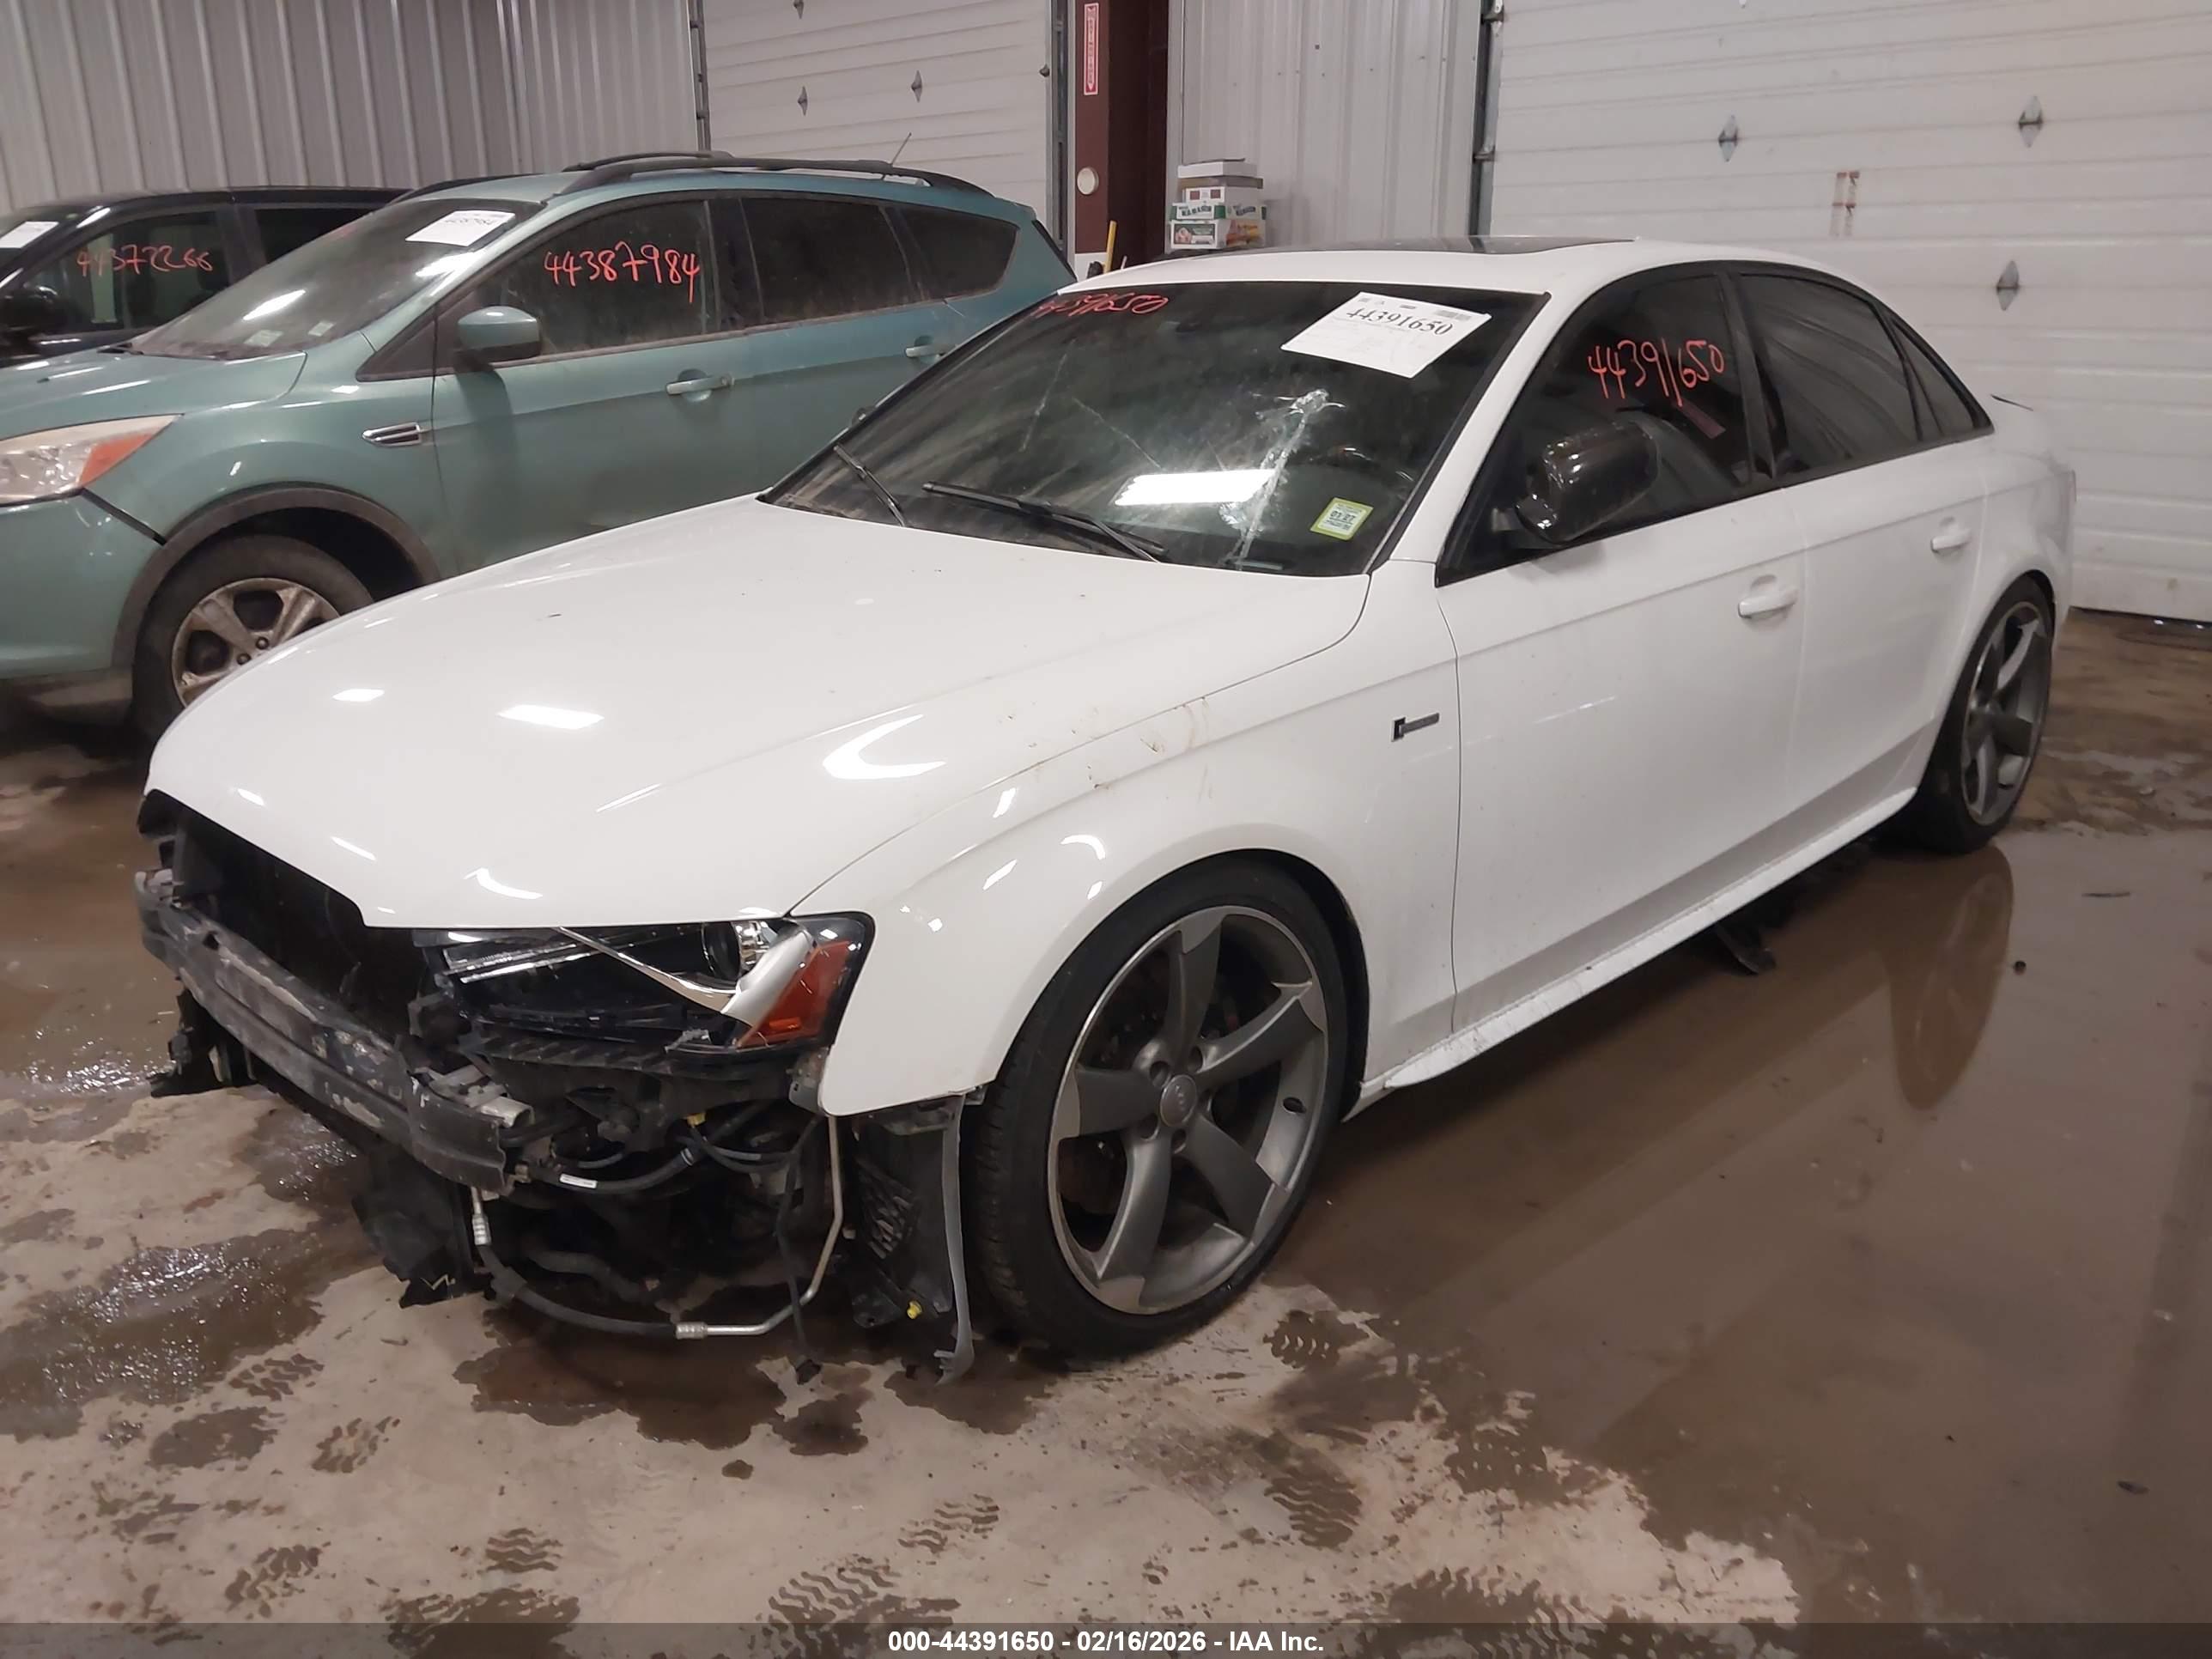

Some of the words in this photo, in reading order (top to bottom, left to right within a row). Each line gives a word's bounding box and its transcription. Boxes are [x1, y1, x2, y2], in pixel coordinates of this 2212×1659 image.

[544, 240, 700, 303] 44387984
[1346, 307, 1454, 336] 44391650
[1587, 337, 1725, 407] 44391650
